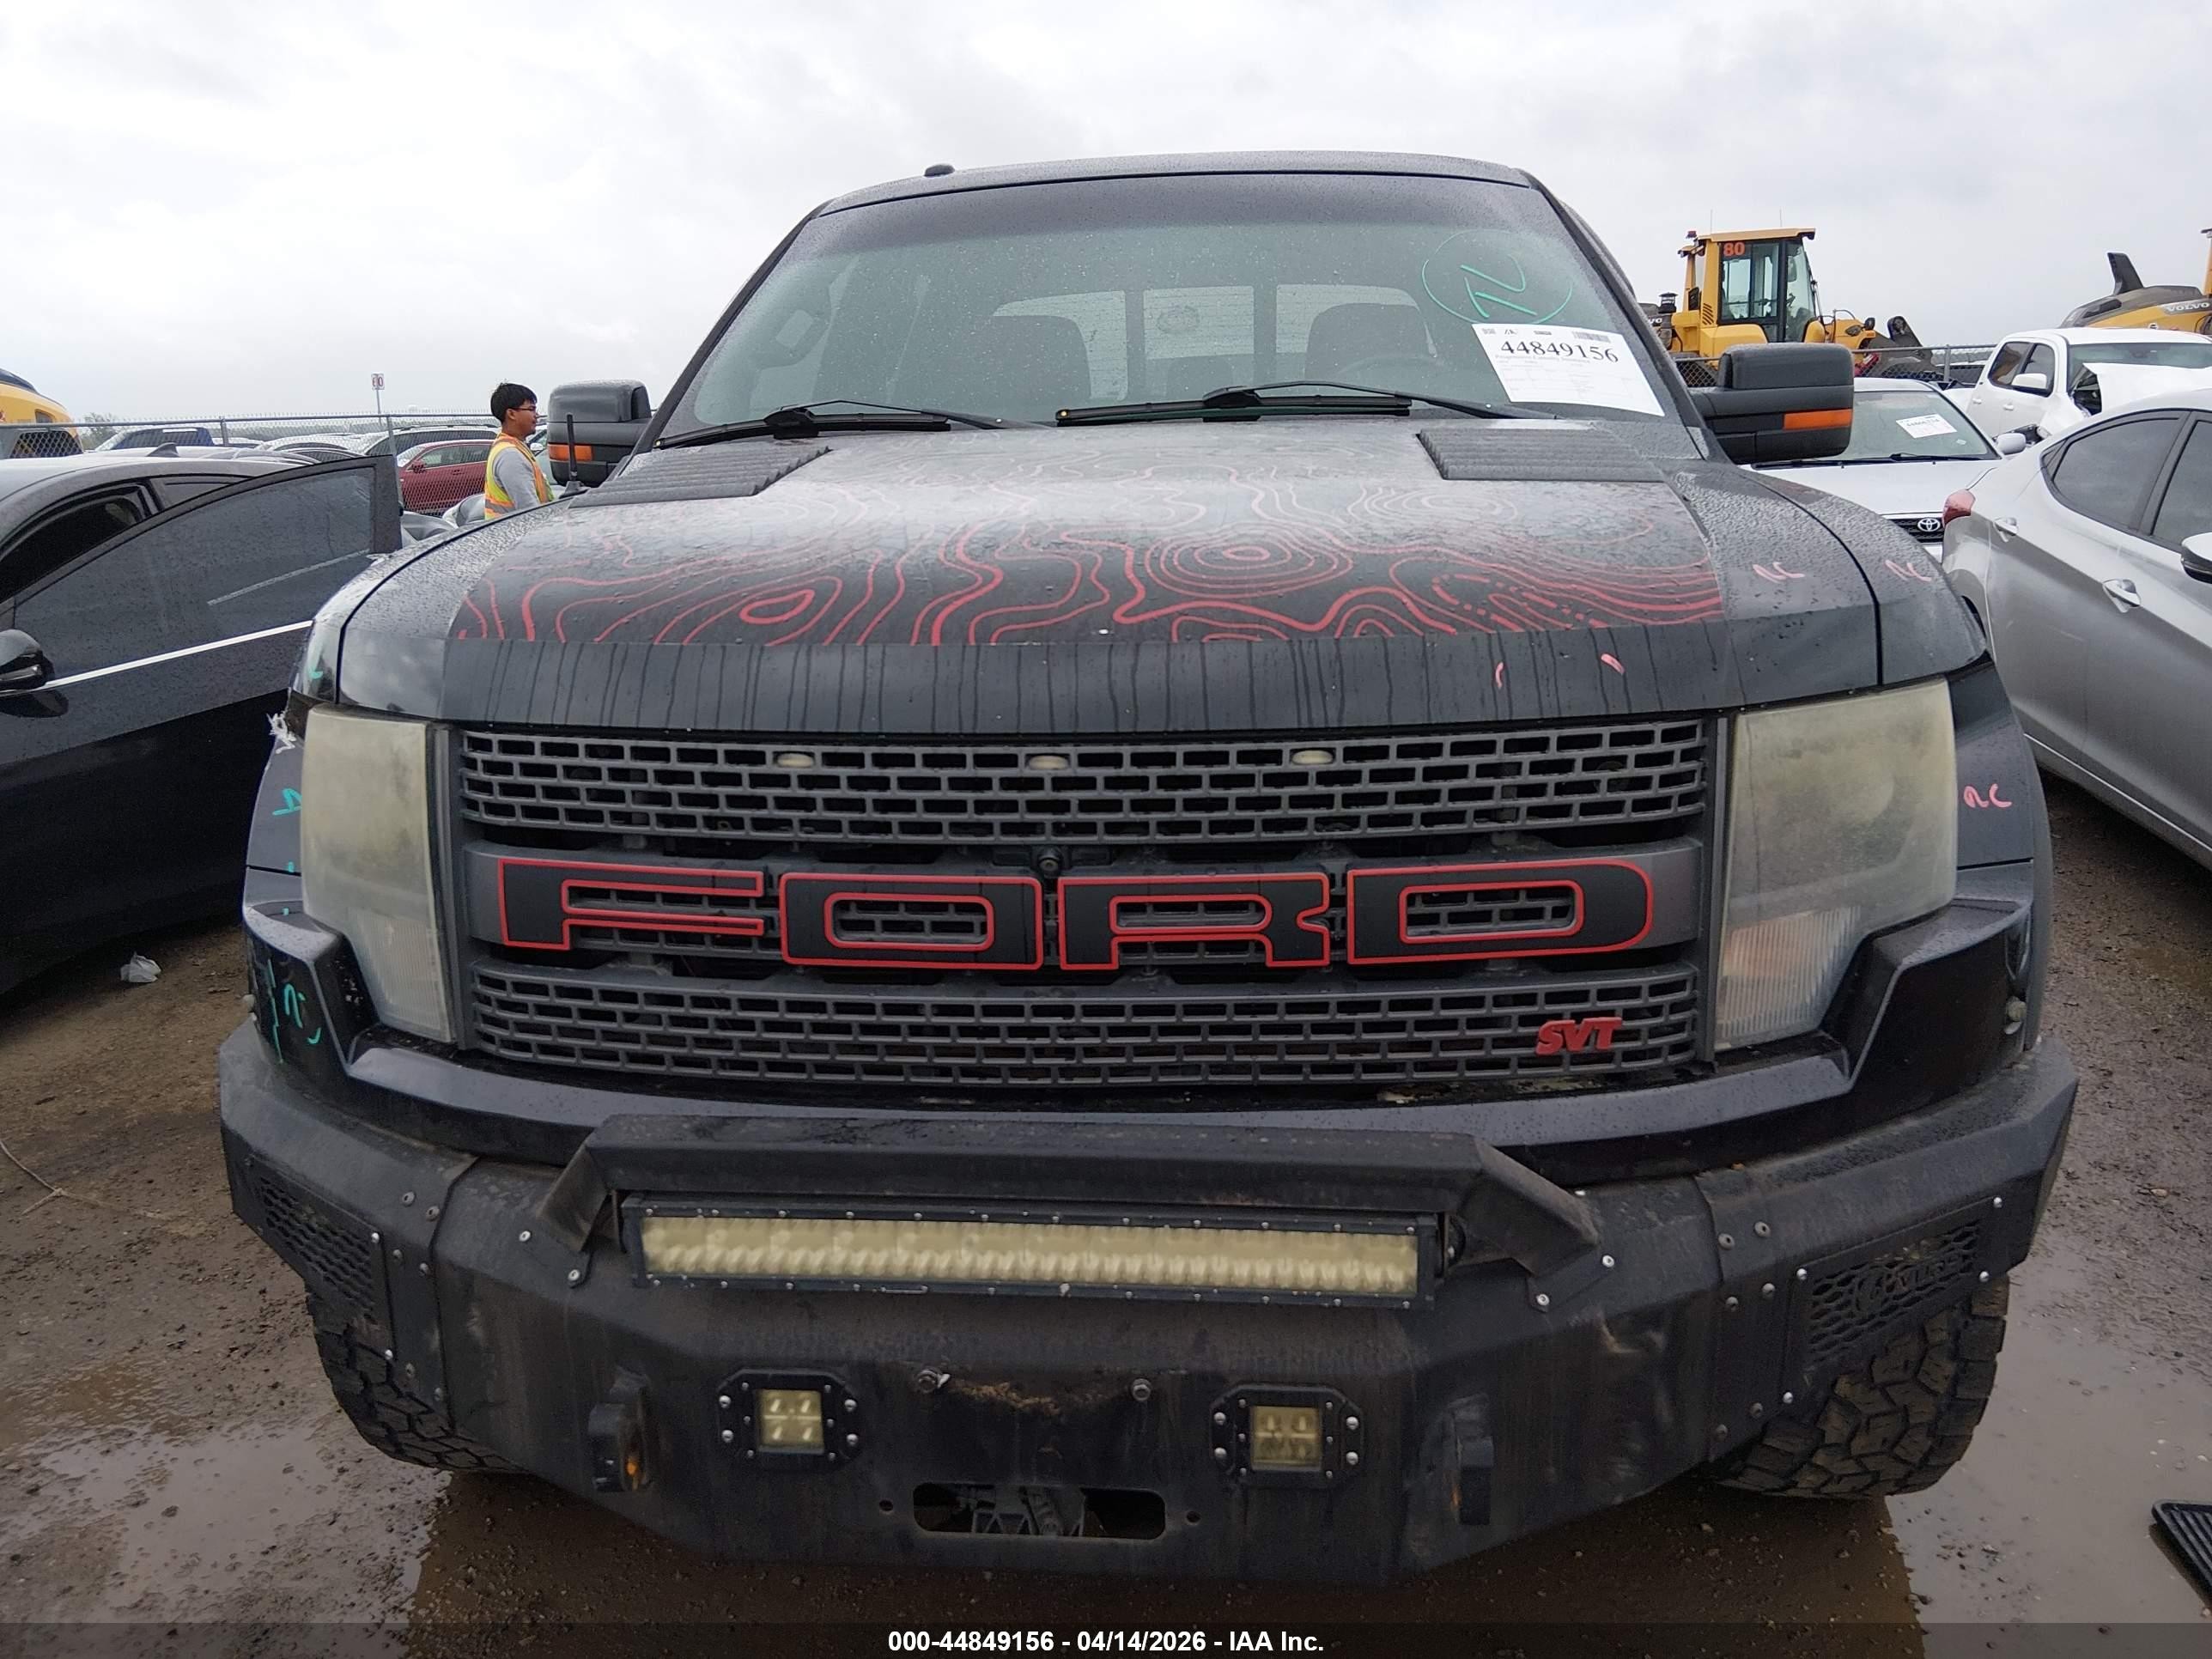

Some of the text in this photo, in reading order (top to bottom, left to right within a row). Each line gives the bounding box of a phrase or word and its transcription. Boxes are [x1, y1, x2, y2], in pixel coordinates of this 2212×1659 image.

[1723, 241, 1745, 256] 80
[2165, 301, 2210, 313] VOLVO
[1500, 340, 1619, 363] 44849156
[498, 856, 1654, 971] FORD
[1535, 1016, 1623, 1055] SVT
